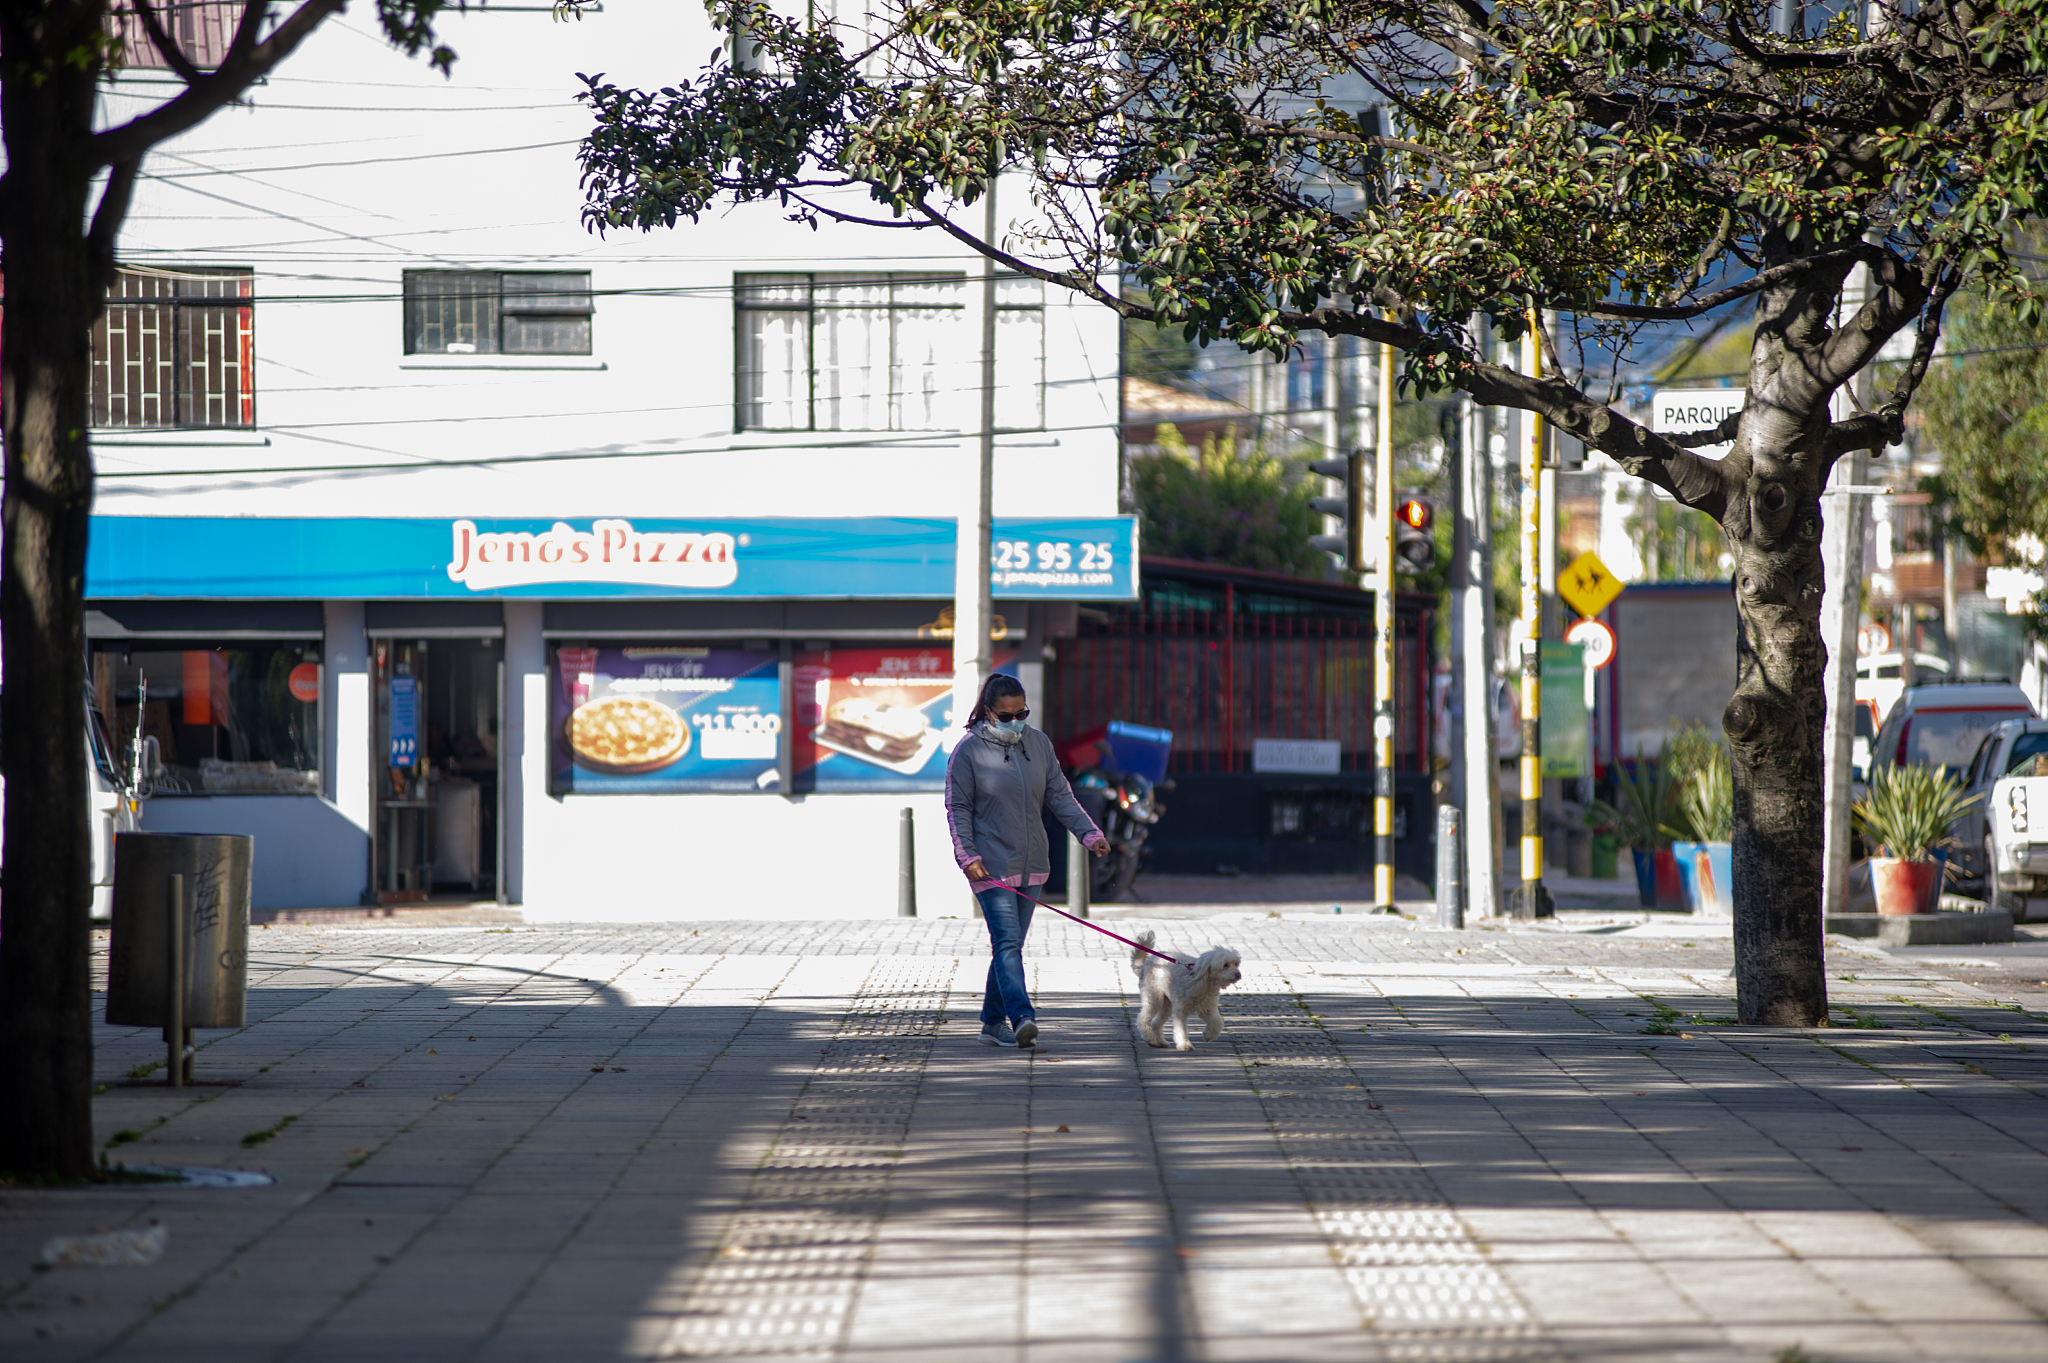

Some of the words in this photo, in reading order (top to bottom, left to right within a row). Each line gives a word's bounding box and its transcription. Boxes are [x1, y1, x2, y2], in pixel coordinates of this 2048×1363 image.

[602, 528, 727, 563] Pizza
[1037, 541, 1072, 571] 95
[1079, 541, 1113, 571] 25
